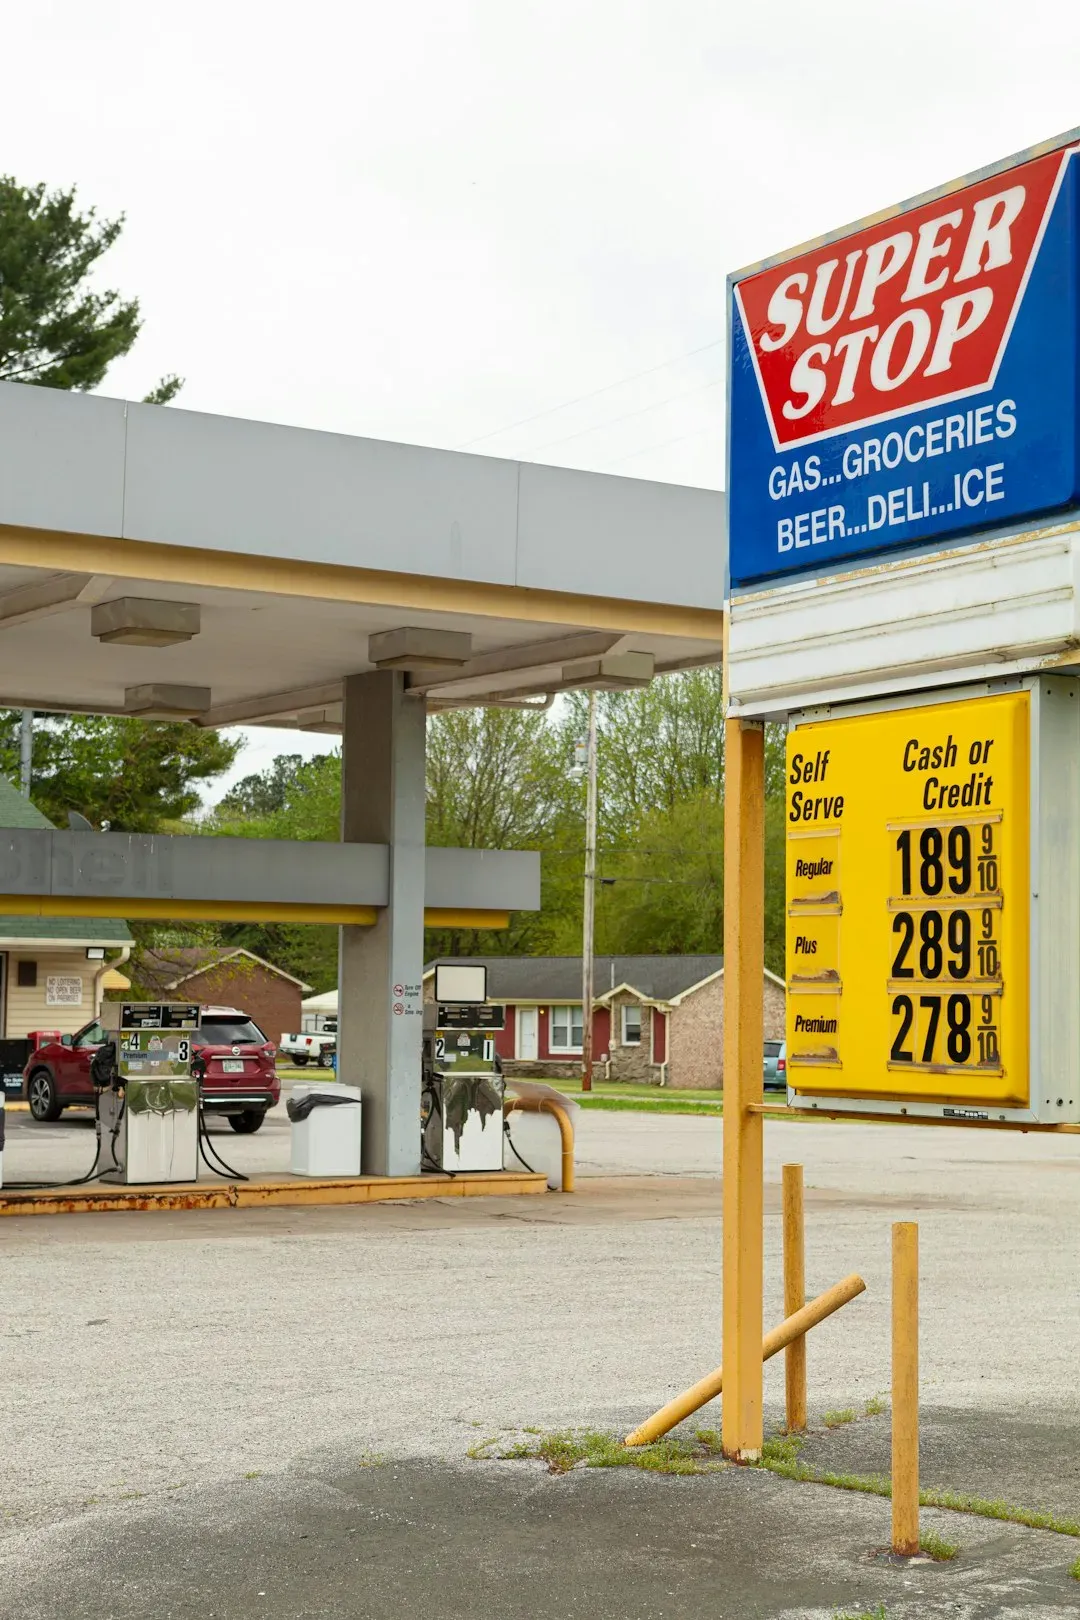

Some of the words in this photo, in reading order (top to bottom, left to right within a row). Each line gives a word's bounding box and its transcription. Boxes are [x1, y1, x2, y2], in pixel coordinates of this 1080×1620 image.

[760, 185, 1027, 353] SUPER
[782, 286, 994, 421] STOP
[789, 750, 831, 786] Self
[903, 734, 958, 773] Cash
[969, 738, 994, 766] or
[789, 790, 845, 823] Serve
[923, 772, 994, 811] Credit
[795, 857, 834, 879] Regular
[897, 825, 971, 897] 189
[795, 936, 818, 955] Plus
[892, 909, 971, 980] 289
[130, 1032, 139, 1050] 4
[795, 1014, 838, 1035] Premium
[891, 994, 971, 1064] 278
[121, 1041, 129, 1051] 4
[123, 1051, 148, 1059] Premium
[179, 1041, 189, 1061] 3
[436, 1039, 444, 1058] 2
